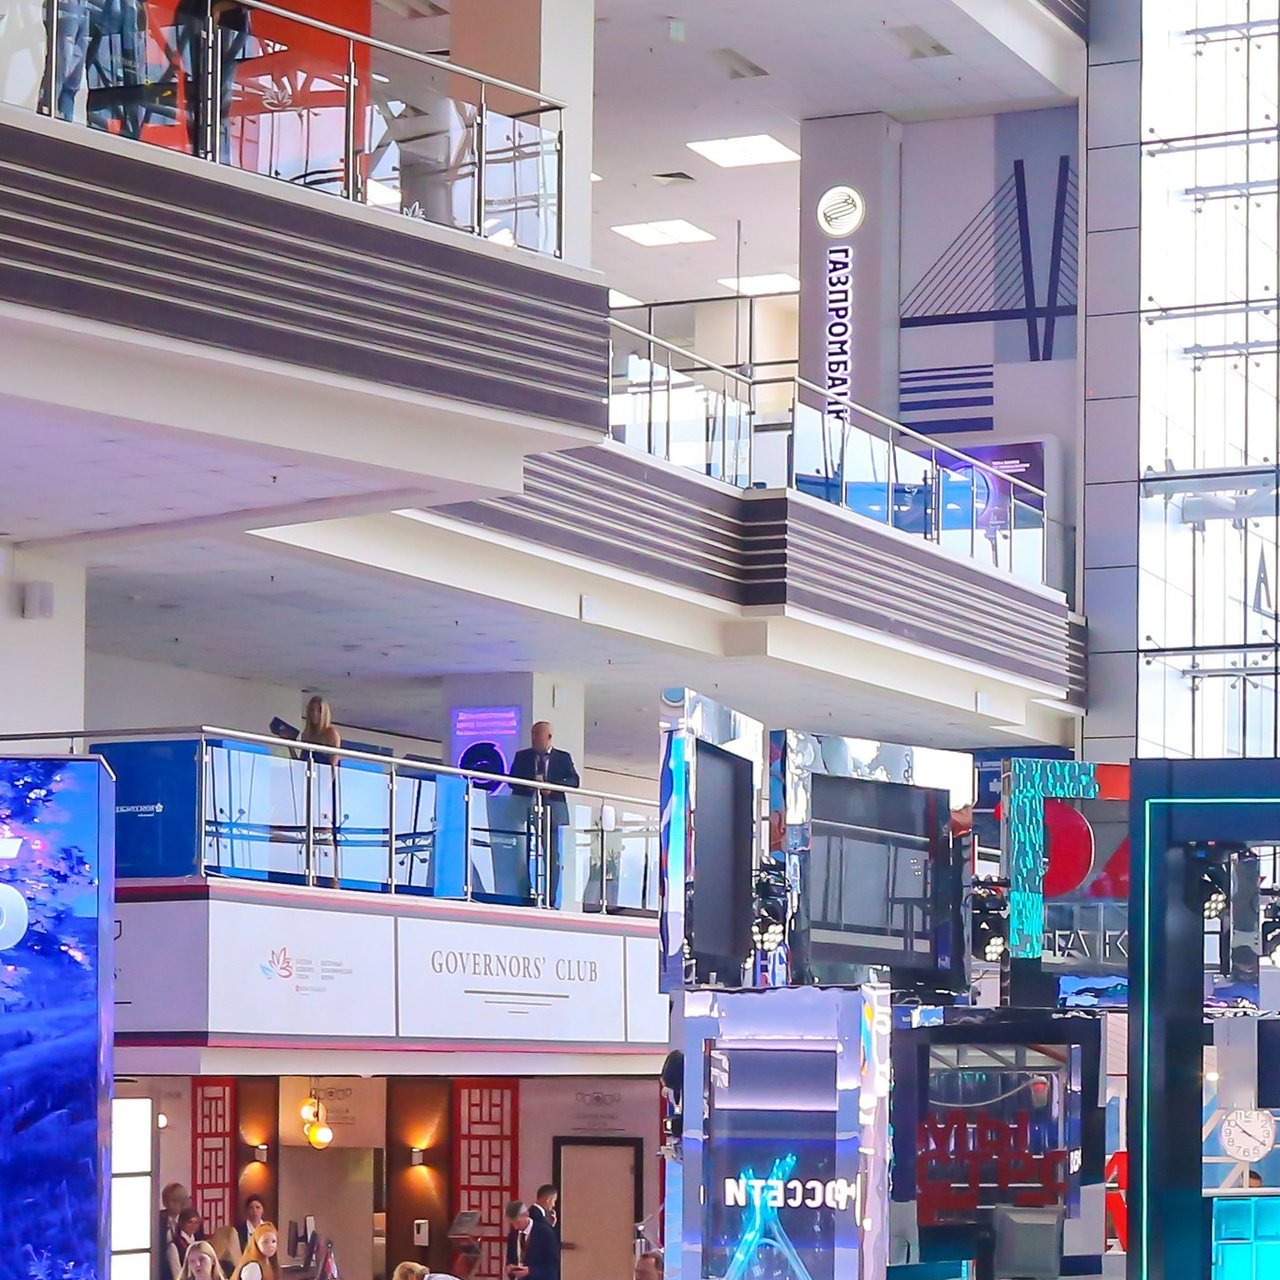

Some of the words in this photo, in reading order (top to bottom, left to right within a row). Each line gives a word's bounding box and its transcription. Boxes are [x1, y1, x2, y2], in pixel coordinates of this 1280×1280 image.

[556, 958, 598, 982] CLUB
[1244, 1111, 1252, 1119] 12
[1260, 1120, 1268, 1128] 2
[1225, 1128, 1232, 1137] 9
[1263, 1129, 1270, 1138] 3
[1227, 1137, 1234, 1146] 8
[1243, 1148, 1250, 1156] 6
[1253, 1146, 1260, 1154] 5
